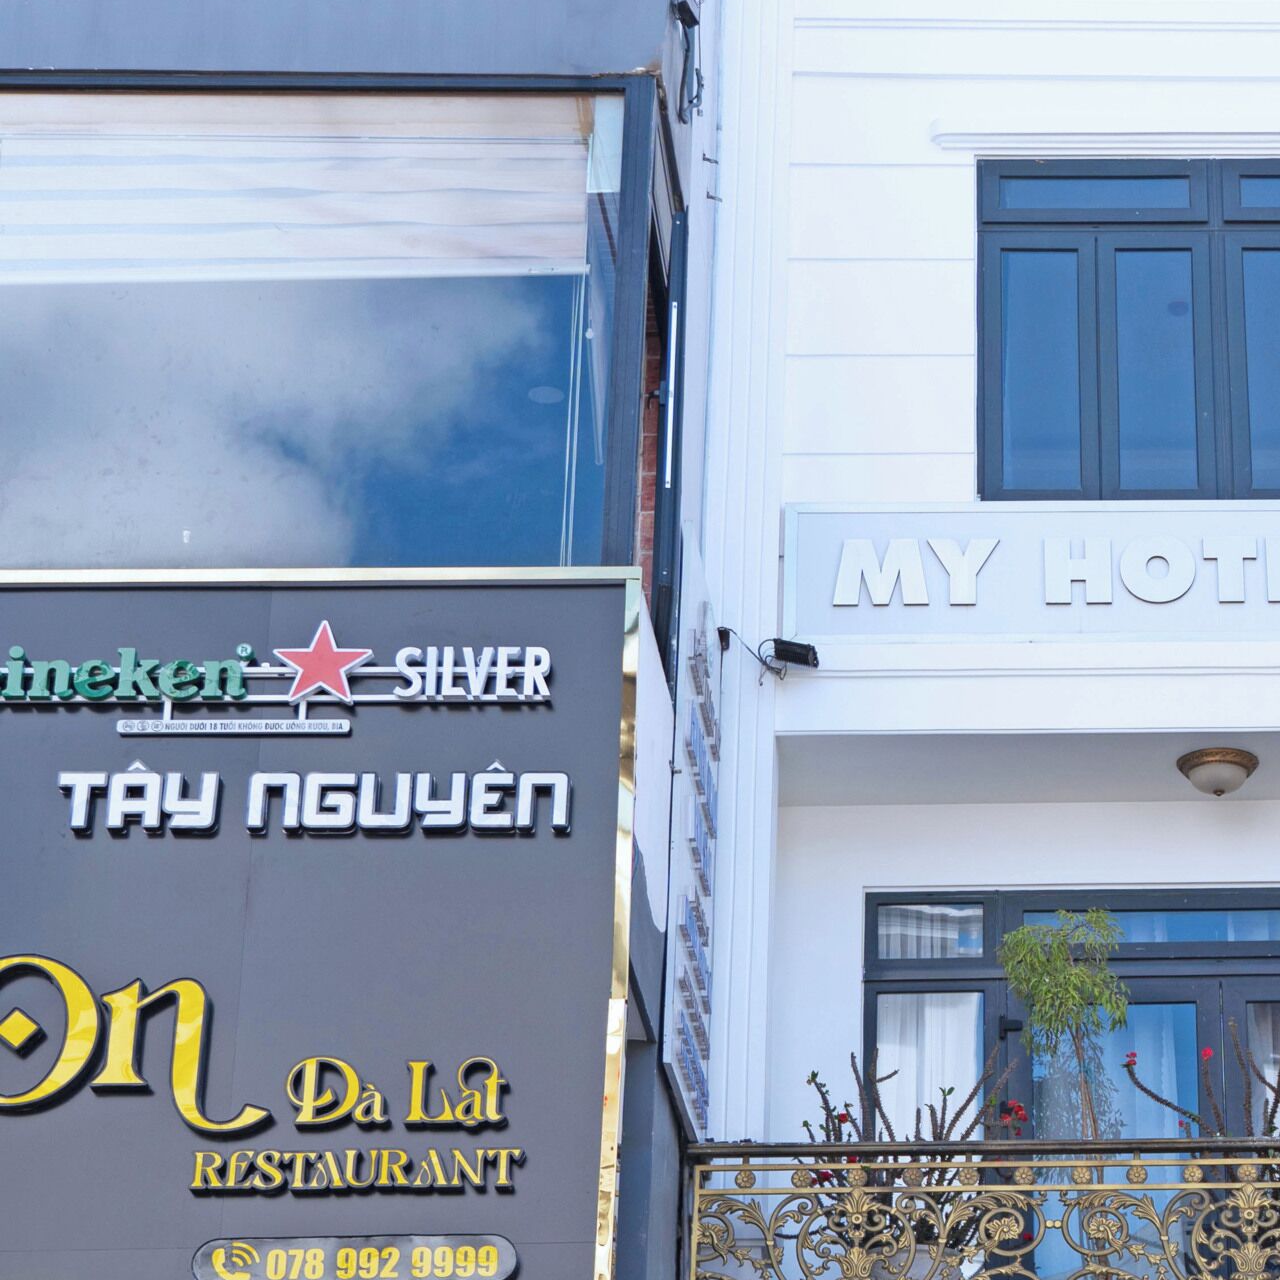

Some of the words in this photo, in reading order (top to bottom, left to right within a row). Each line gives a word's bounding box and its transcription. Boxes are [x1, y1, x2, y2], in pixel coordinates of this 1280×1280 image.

[832, 537, 1001, 607] MY
[0, 645, 248, 701] ineken
[392, 646, 551, 699] SILVER
[58, 759, 220, 832] TÂY
[245, 759, 572, 832] NGUYÊN
[406, 1056, 507, 1126] Lạt
[190, 1148, 523, 1191] RESTAURANT
[335, 1247, 400, 1280] 992
[411, 1246, 499, 1279] 9999
